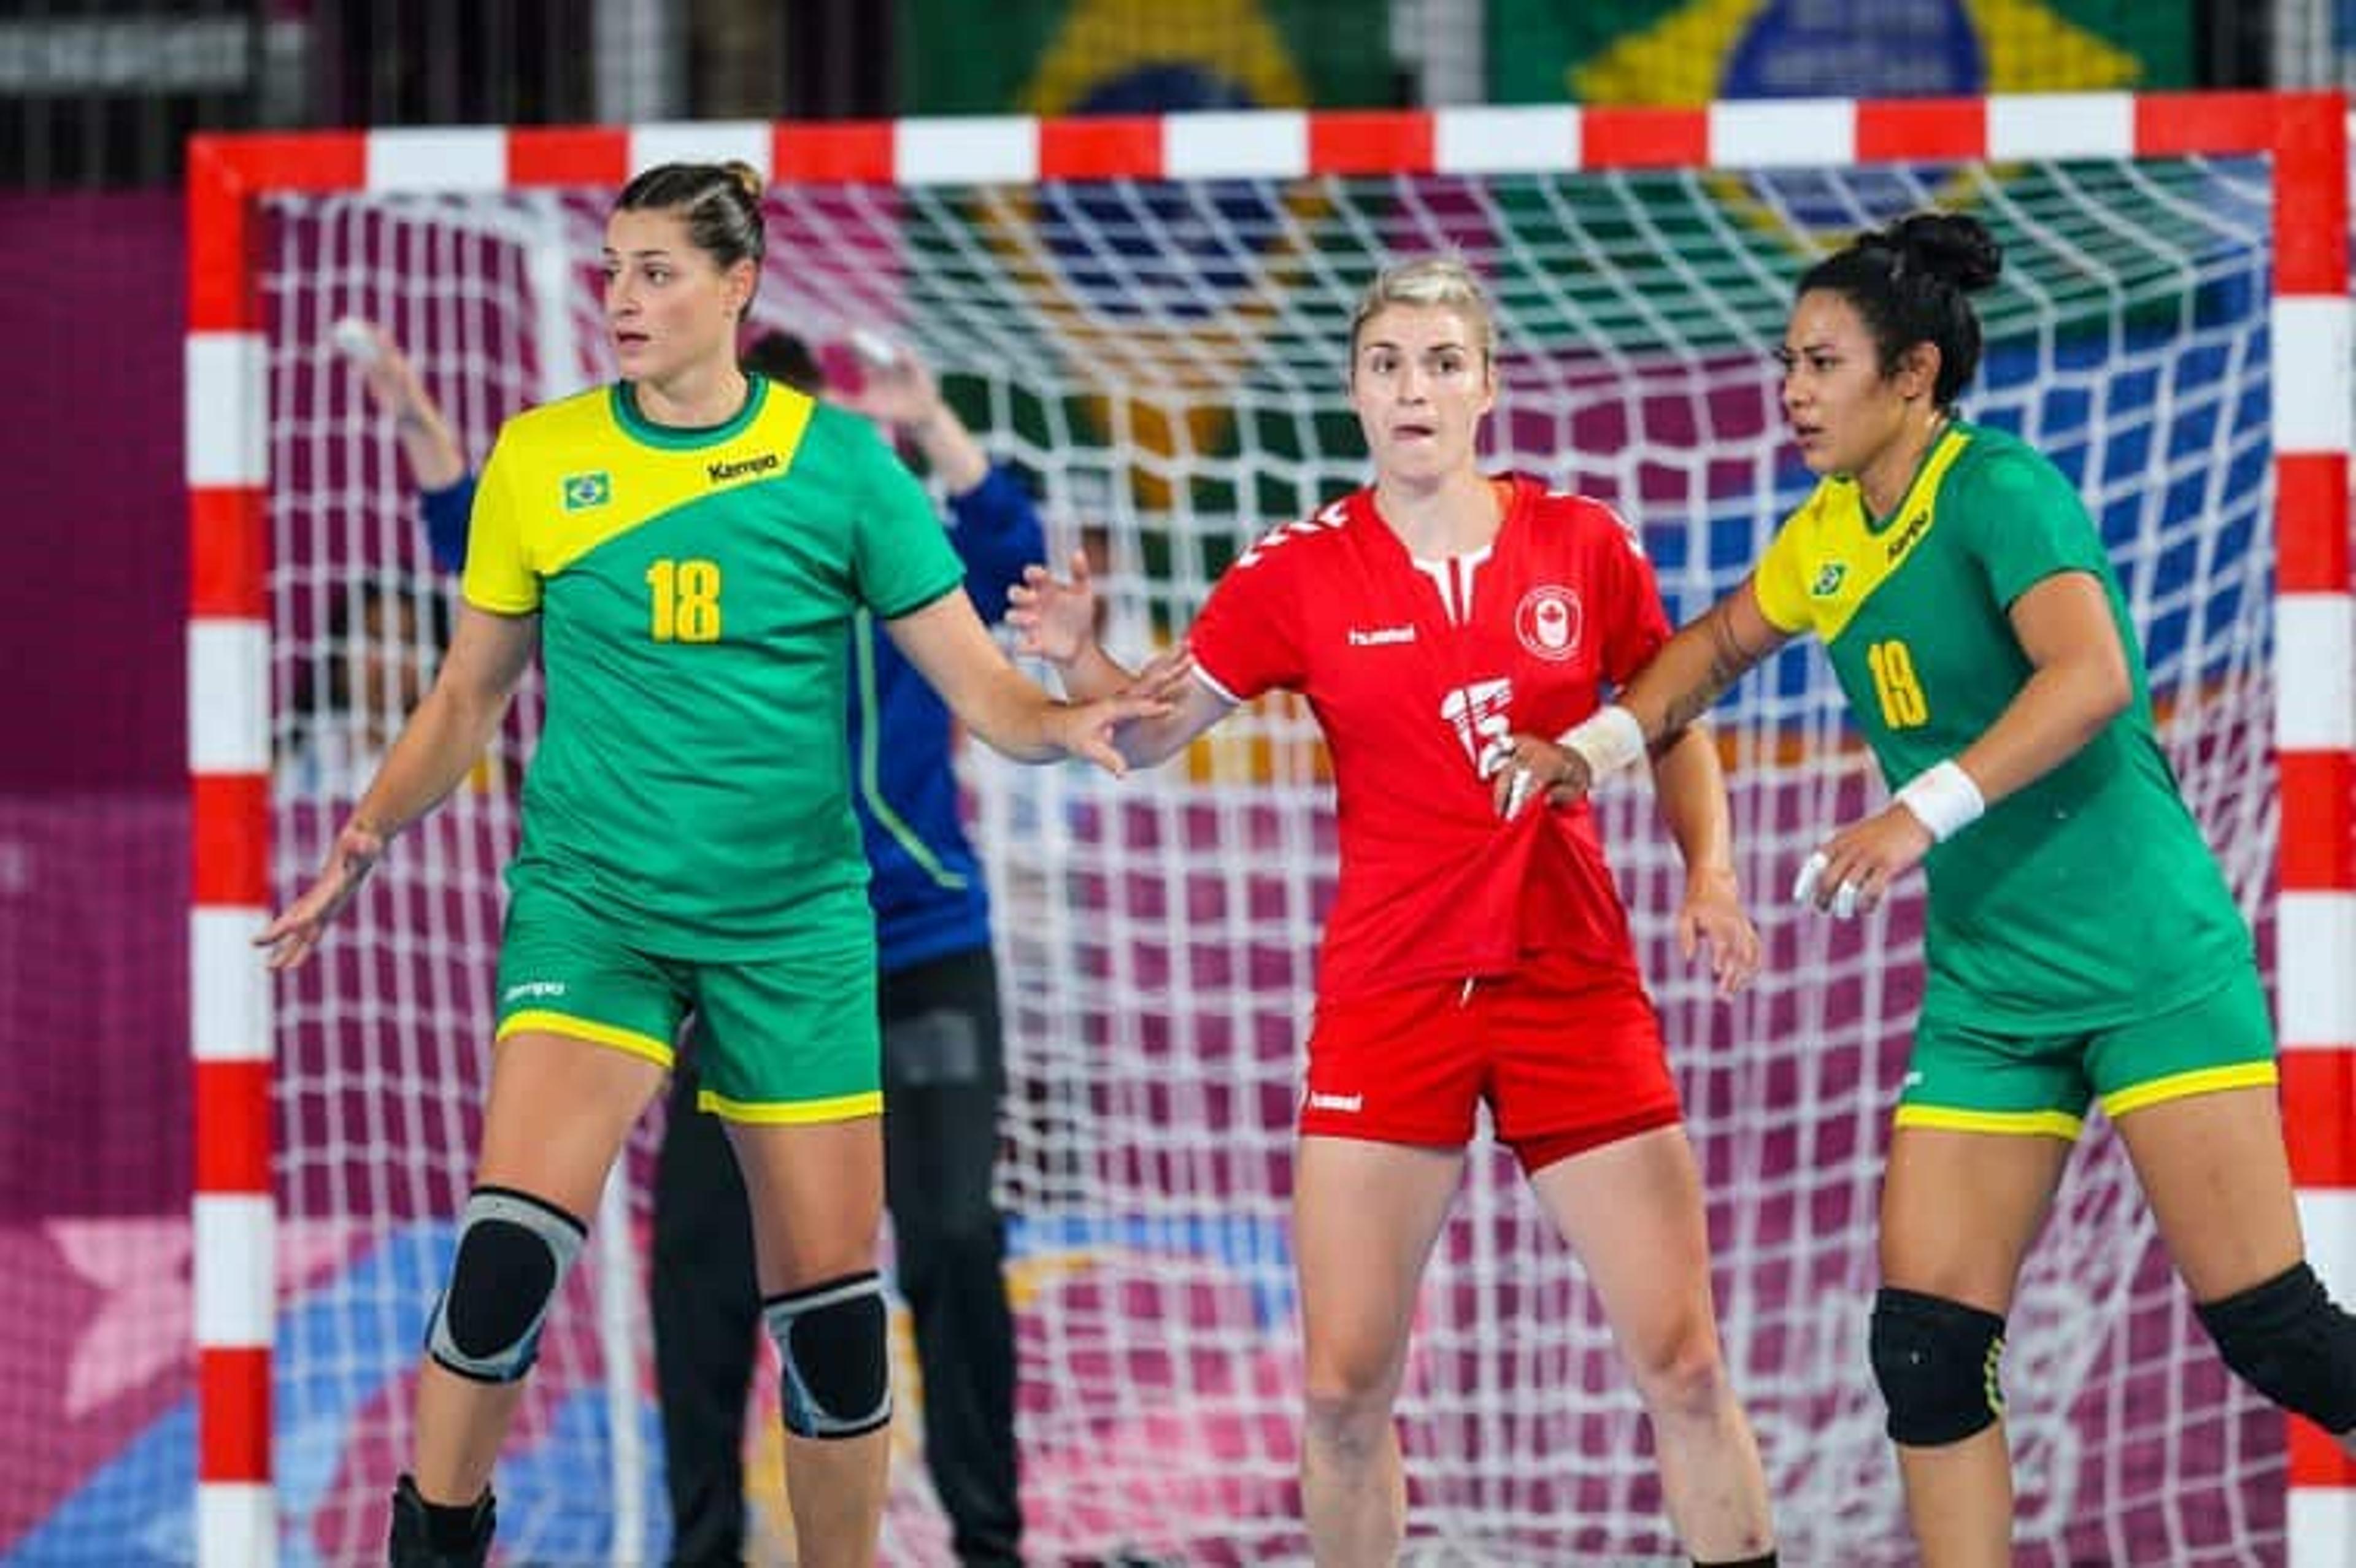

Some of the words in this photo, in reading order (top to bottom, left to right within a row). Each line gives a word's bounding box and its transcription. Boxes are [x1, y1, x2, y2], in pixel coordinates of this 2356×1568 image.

[646, 559, 720, 642] 18
[1441, 677, 1514, 780] 15
[1869, 640, 1928, 729] 19
